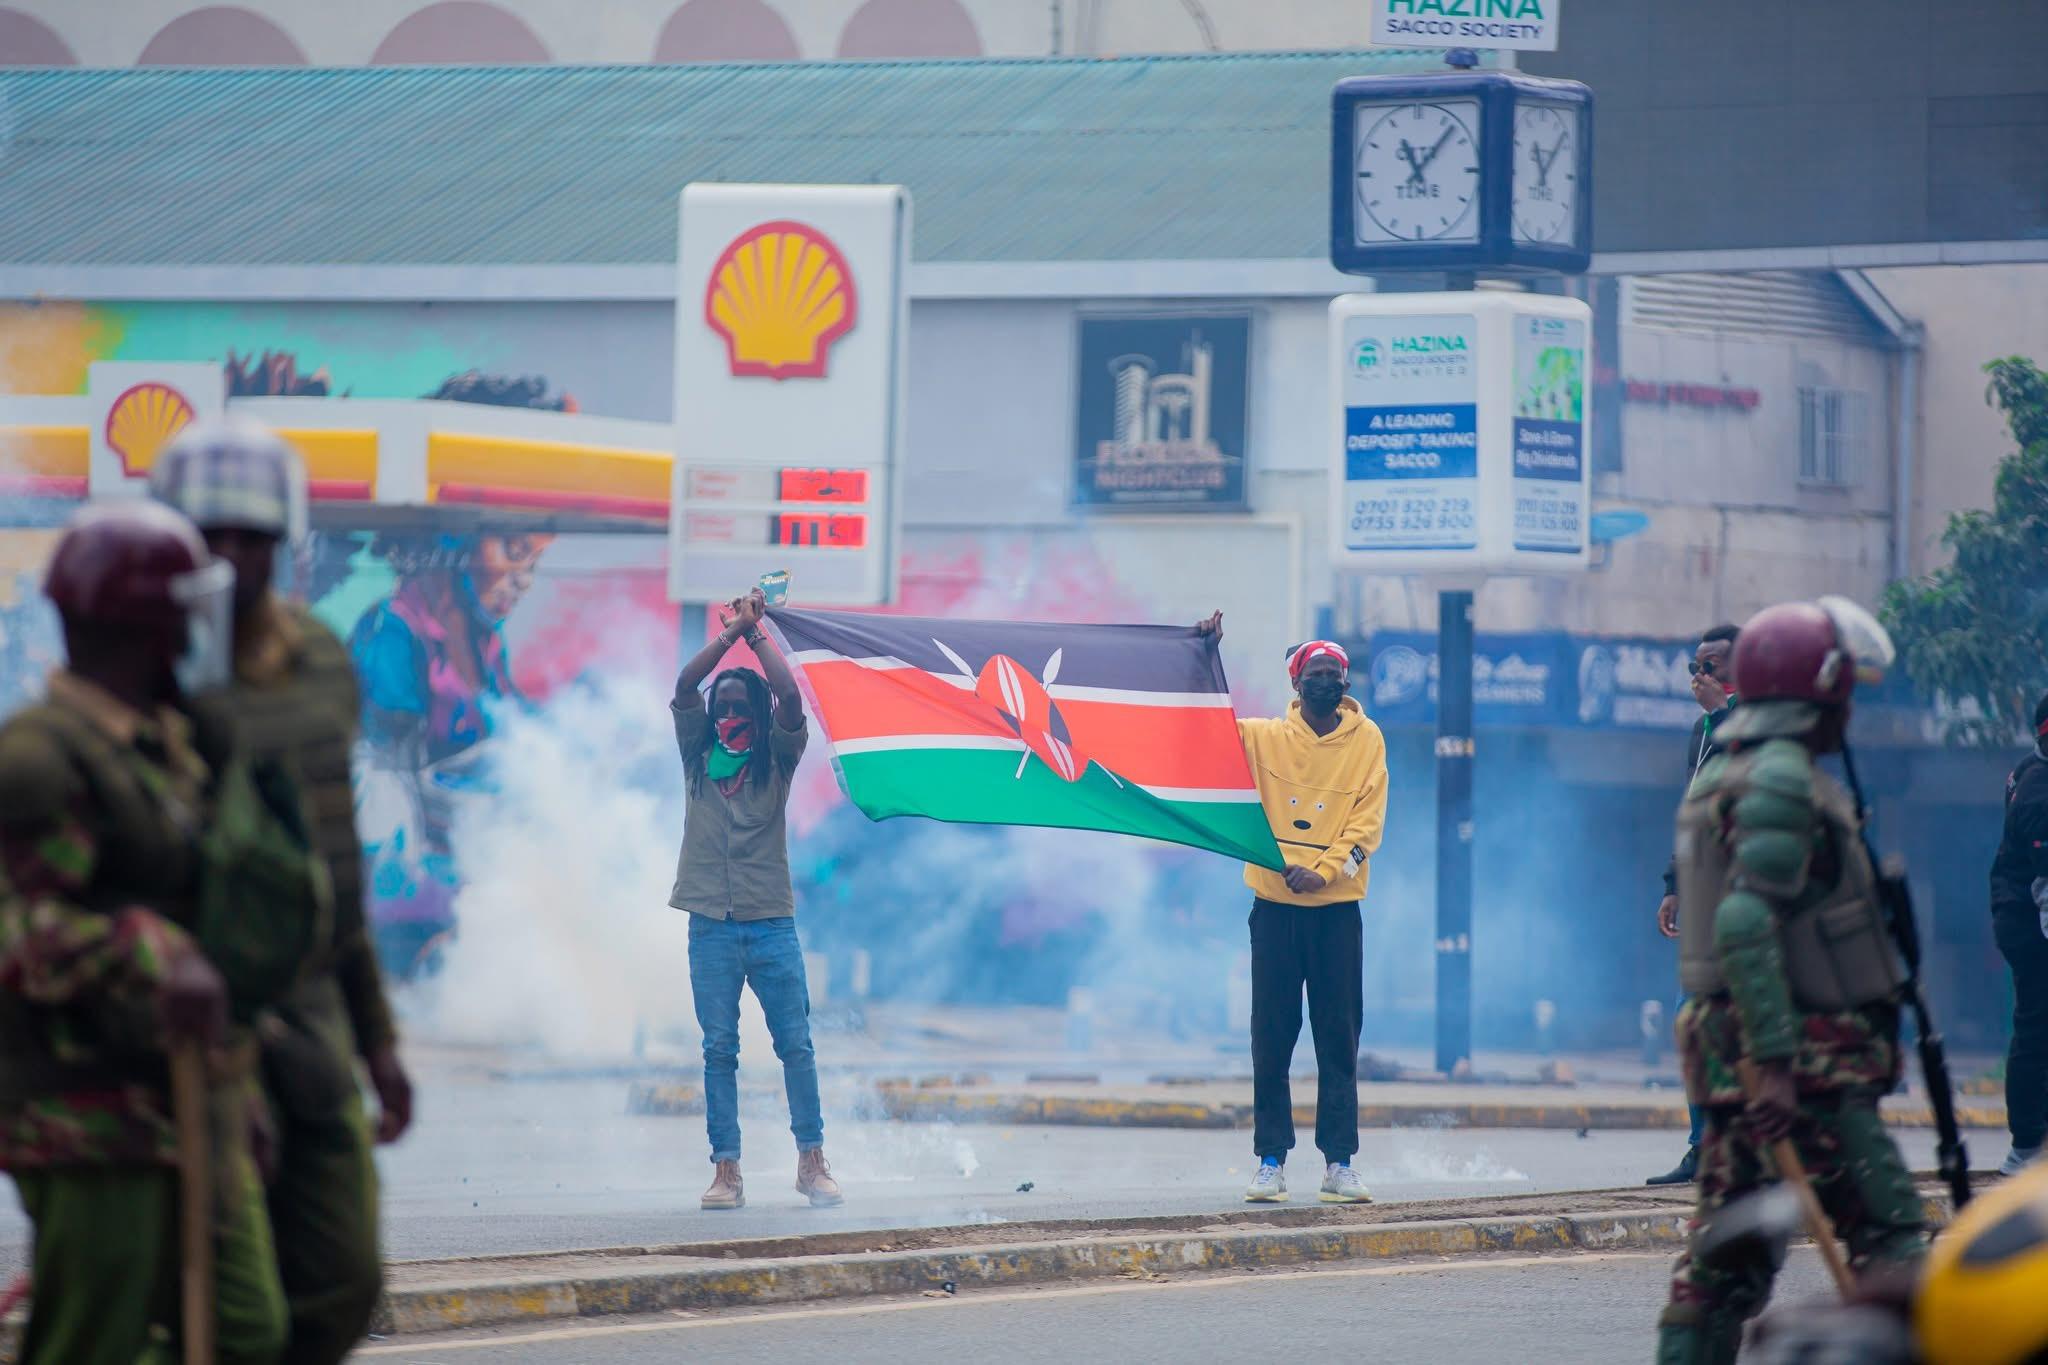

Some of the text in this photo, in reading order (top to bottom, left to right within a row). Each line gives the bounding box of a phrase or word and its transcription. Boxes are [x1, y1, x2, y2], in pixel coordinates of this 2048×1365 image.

[1387, 0, 1545, 19] HAZINA
[1386, 19, 1544, 39] SACCO SOCIETY
[1394, 184, 1440, 199] TIME
[1390, 335, 1469, 352] HAZINA
[1369, 412, 1455, 429] A LEADING
[1384, 452, 1441, 469] SACCO
